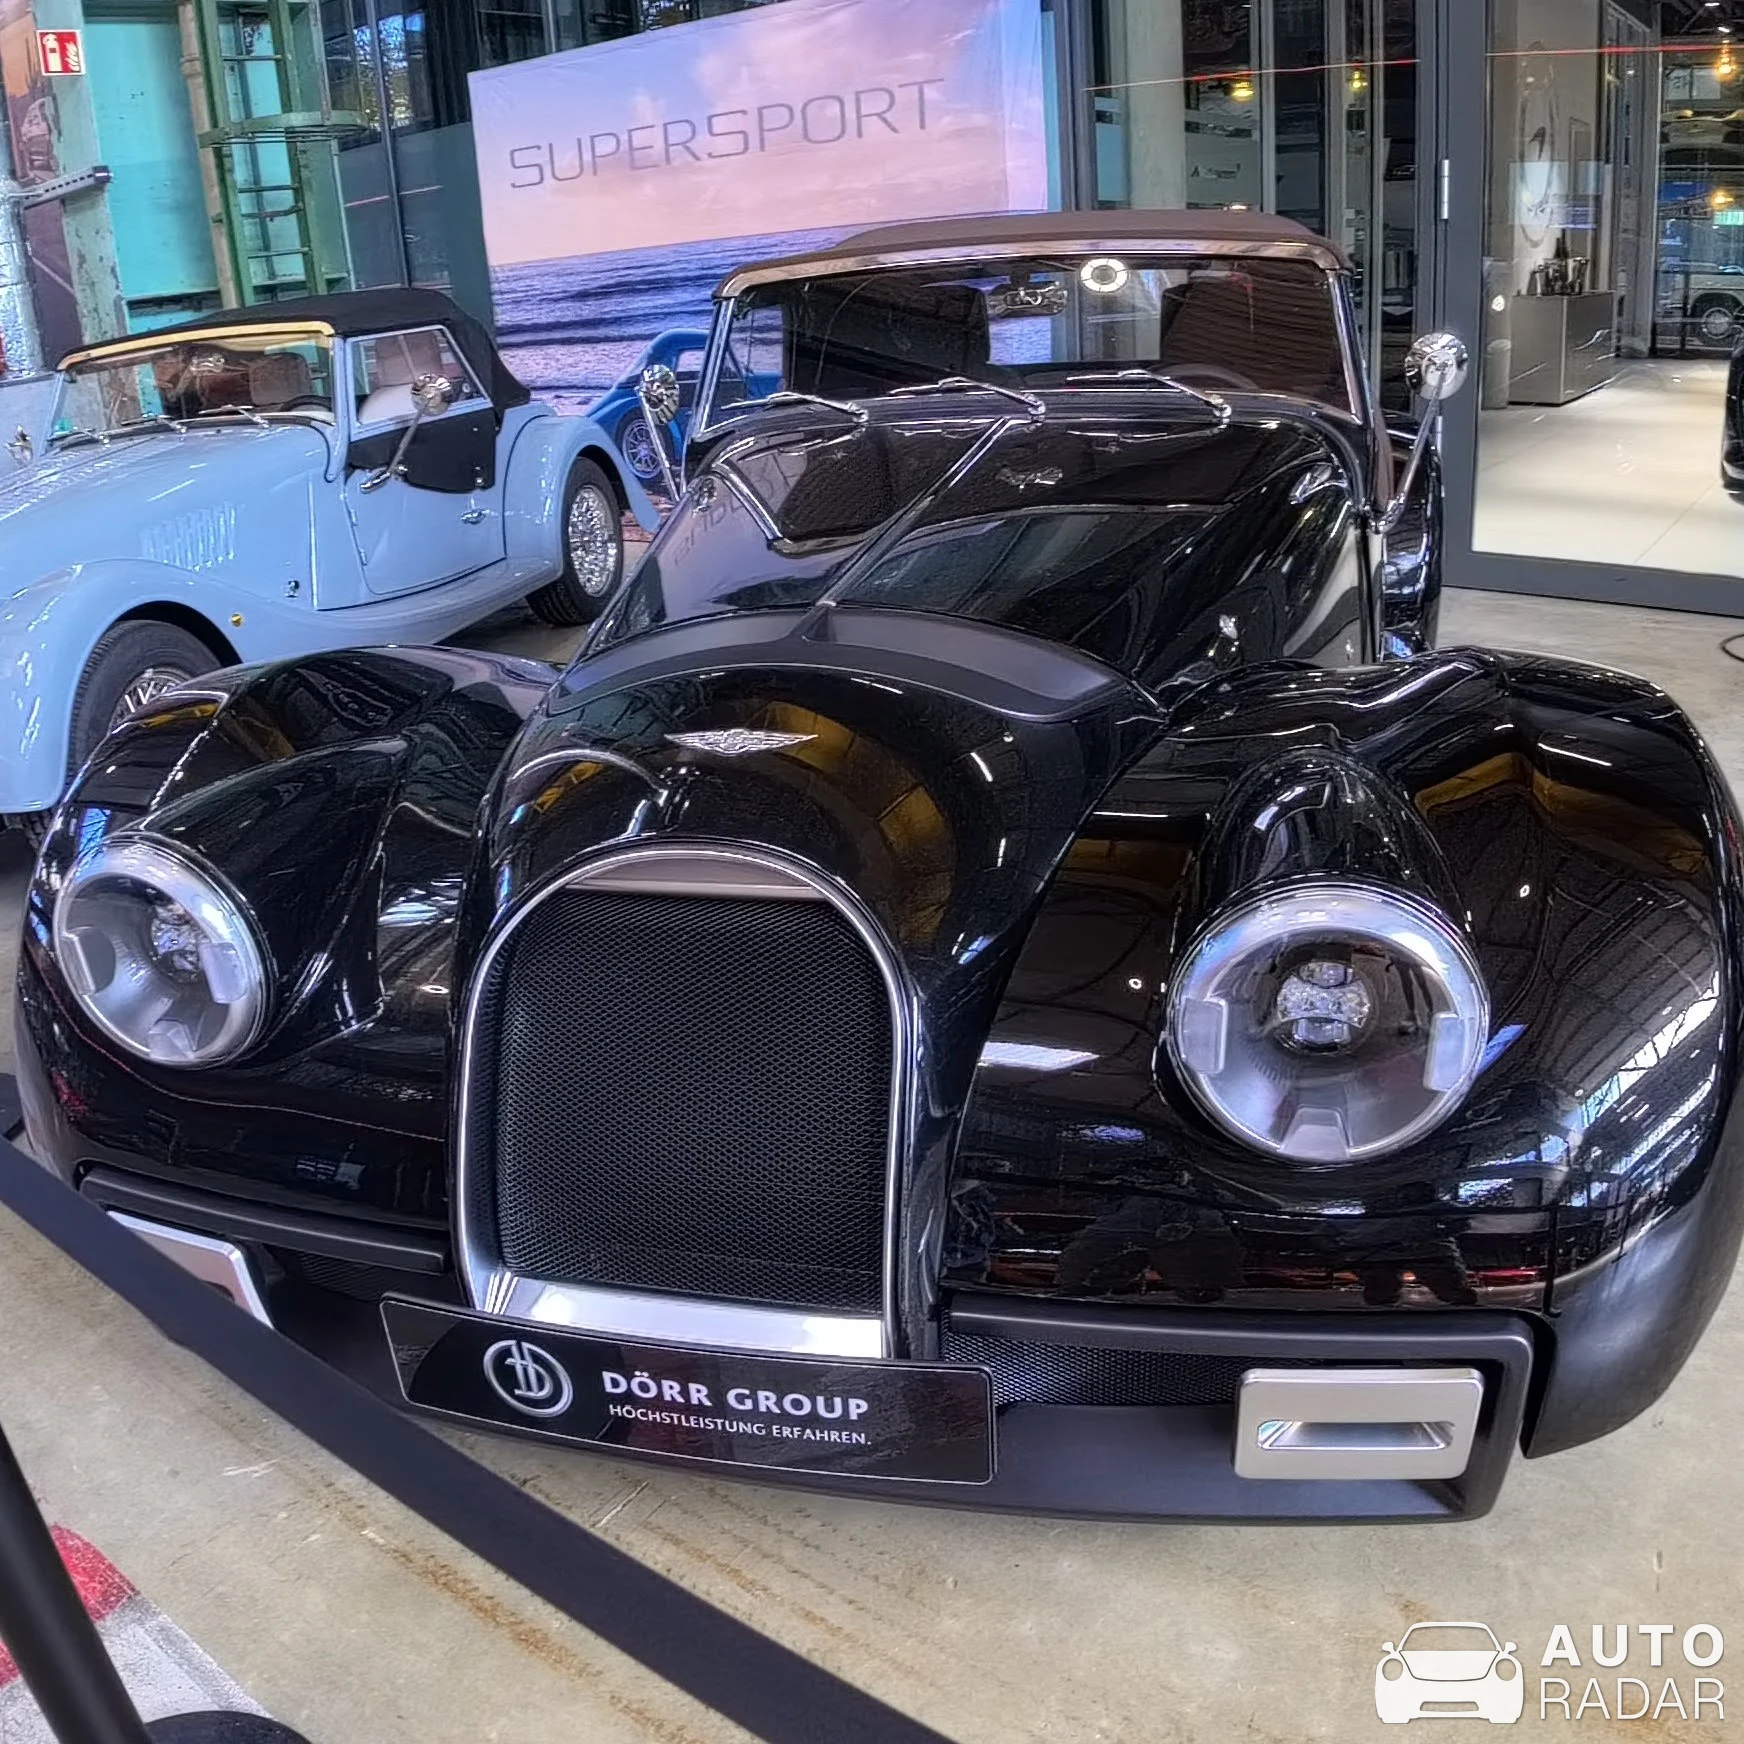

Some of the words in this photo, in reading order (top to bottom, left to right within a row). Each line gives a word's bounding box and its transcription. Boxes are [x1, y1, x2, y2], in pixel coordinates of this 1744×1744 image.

[508, 77, 945, 189] SUPERSPORT
[601, 1370, 713, 1407] DÖRR
[726, 1387, 869, 1421] GROUP
[608, 1403, 767, 1436] HÖCHSTLEISTUNG
[772, 1424, 872, 1446] ERFAHREN.
